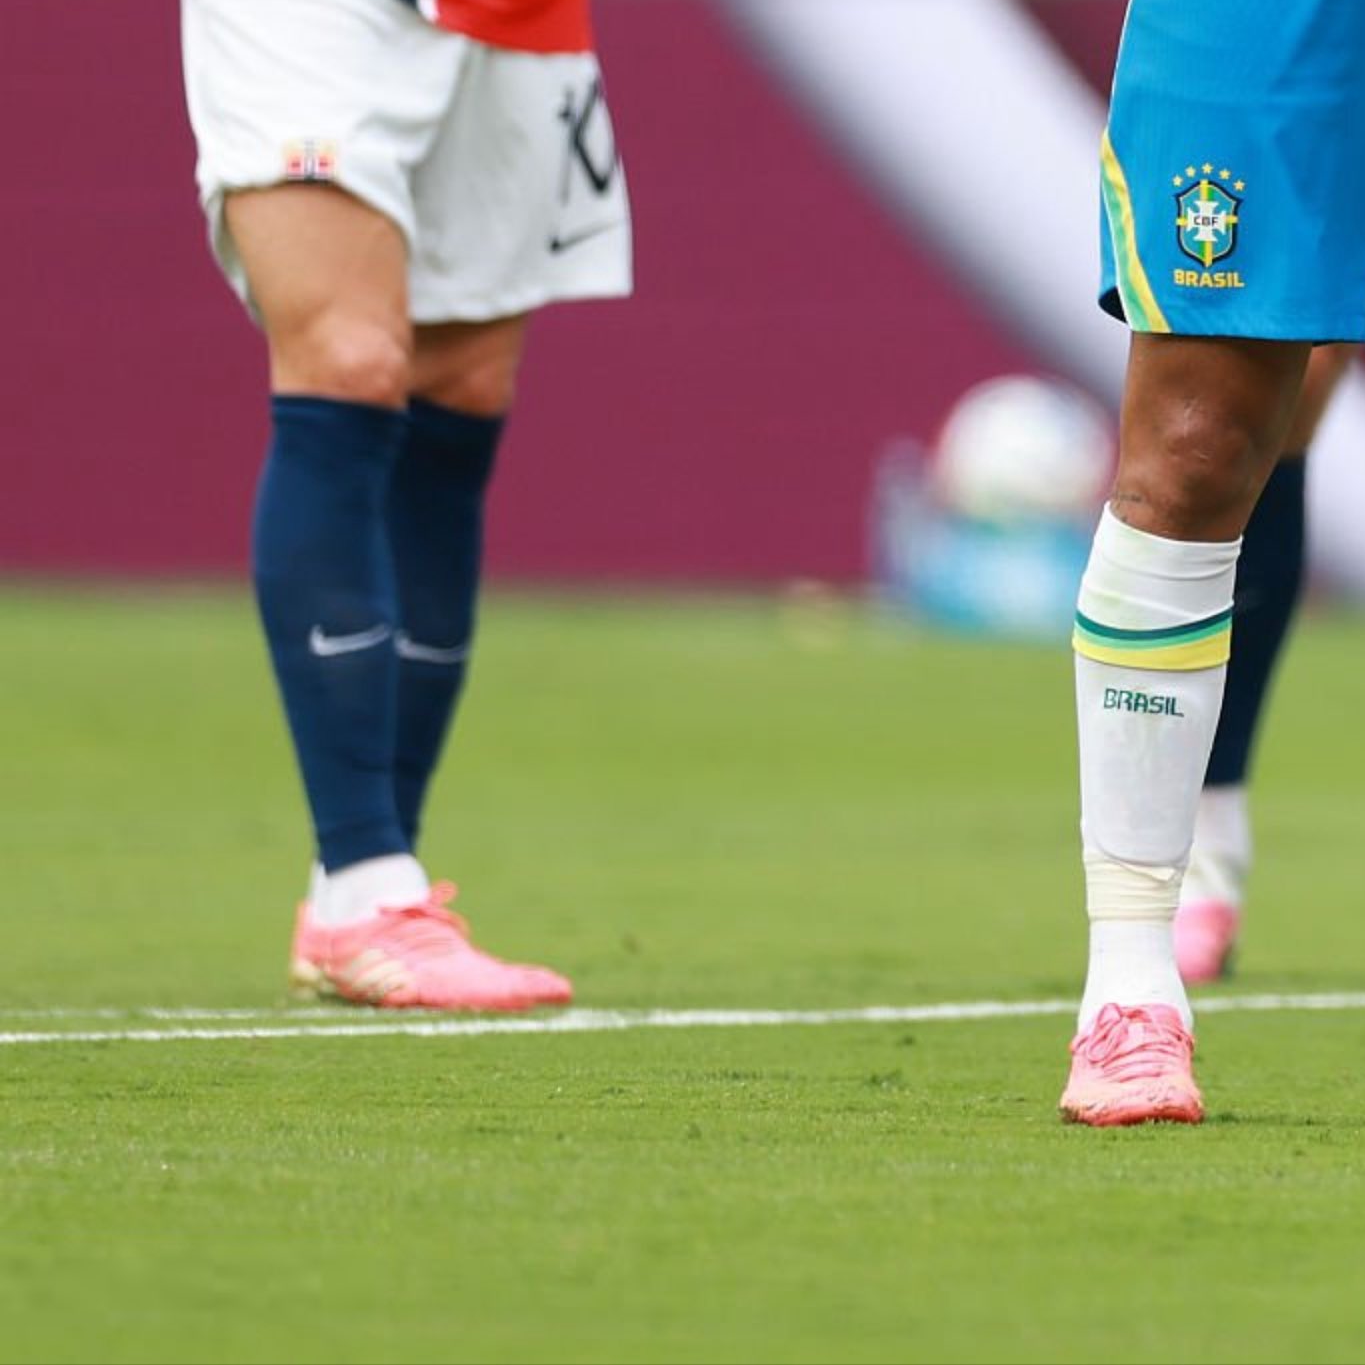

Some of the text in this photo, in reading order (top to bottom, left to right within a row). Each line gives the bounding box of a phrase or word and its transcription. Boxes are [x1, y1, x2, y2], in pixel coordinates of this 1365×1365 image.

[1193, 216, 1219, 226] CBF
[1173, 269, 1245, 288] BRASIL
[1103, 688, 1185, 718] BRASIL
